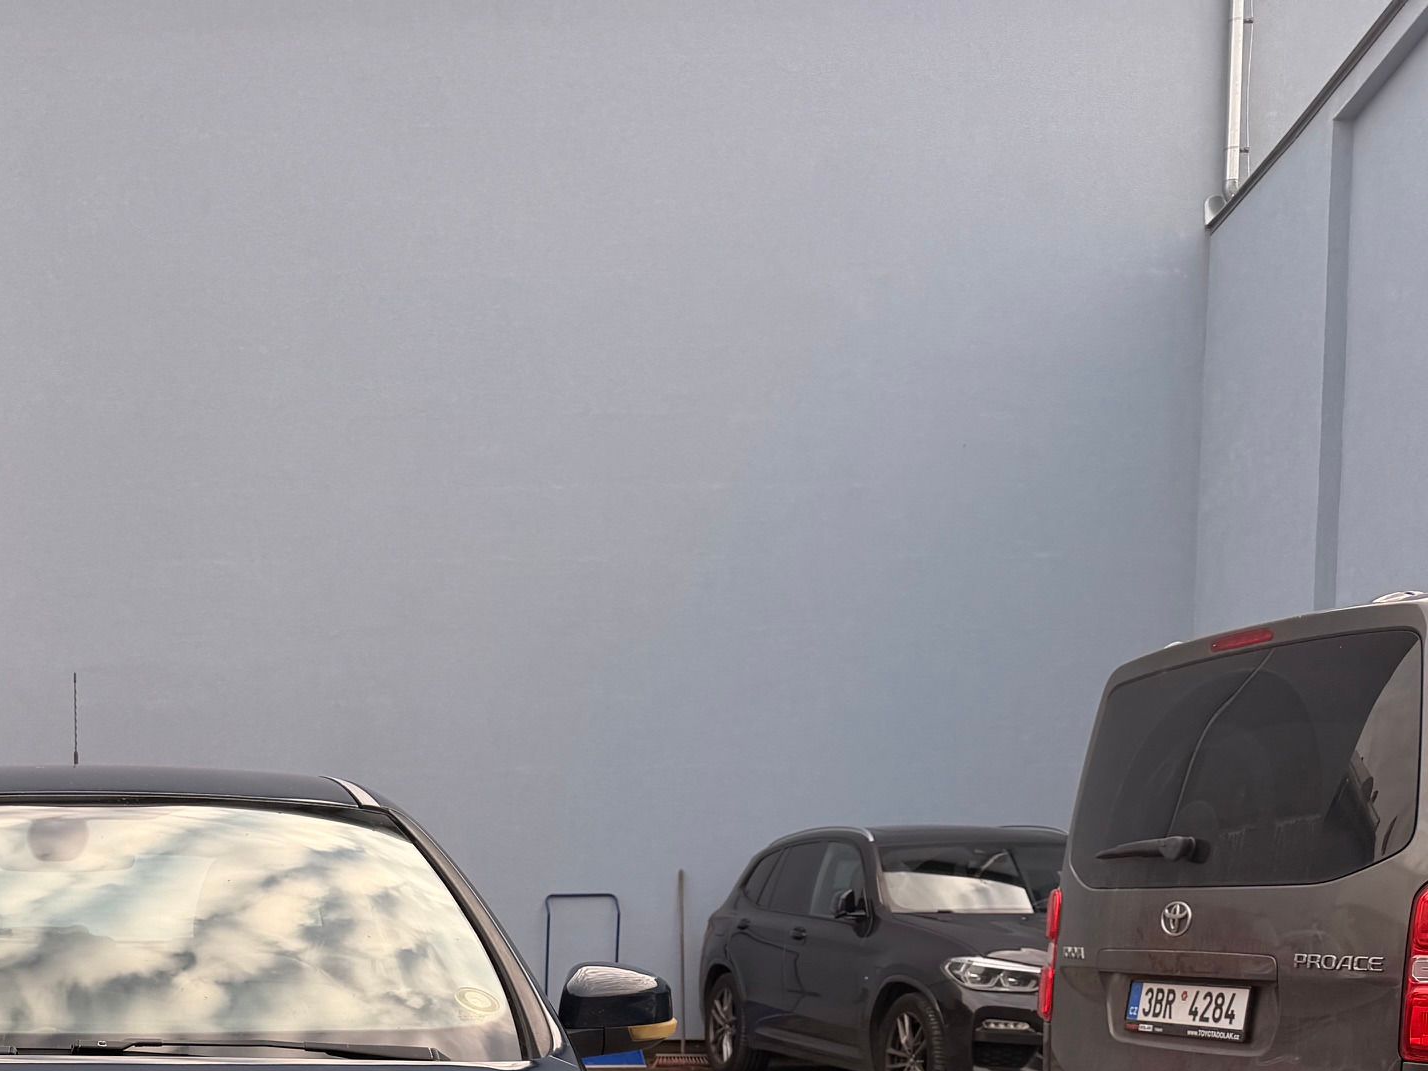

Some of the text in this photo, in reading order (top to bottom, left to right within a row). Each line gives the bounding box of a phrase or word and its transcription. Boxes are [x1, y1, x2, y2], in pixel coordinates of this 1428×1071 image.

[1293, 953, 1384, 972] PROACE
[1128, 1006, 1138, 1016] CZ
[1142, 987, 1237, 1025] 3BR 4284
